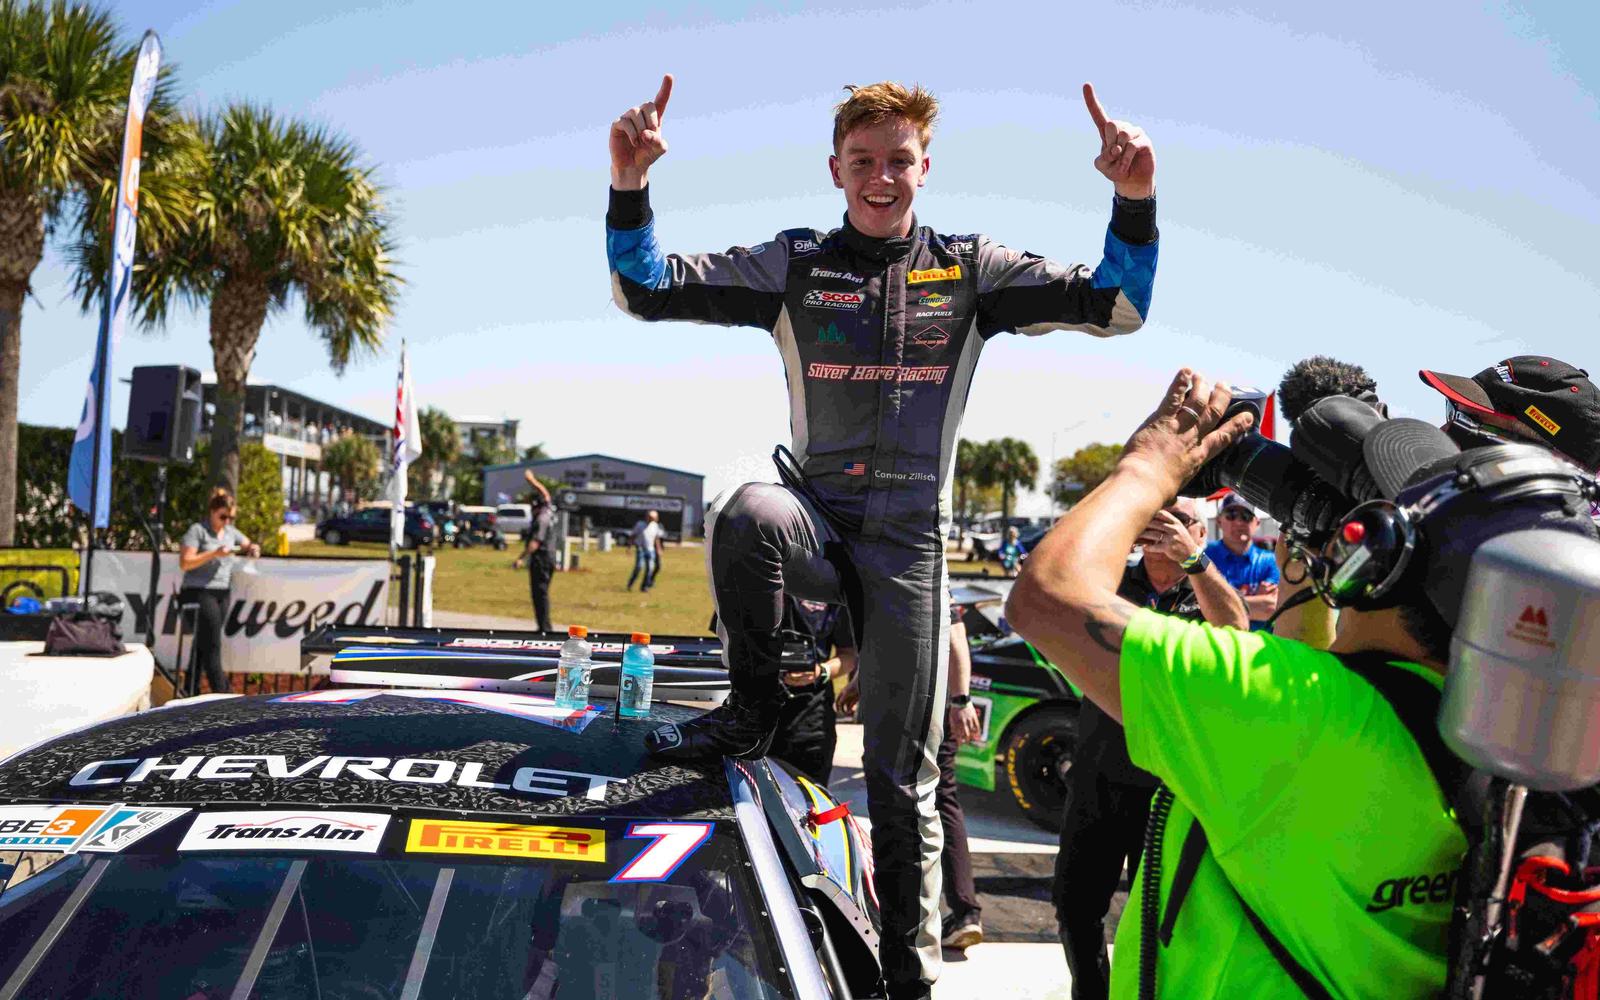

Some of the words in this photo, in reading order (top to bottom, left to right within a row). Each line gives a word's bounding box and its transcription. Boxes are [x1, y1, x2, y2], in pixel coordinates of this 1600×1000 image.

[809, 267, 842, 279] Trans
[842, 272, 864, 284] Am
[911, 266, 957, 281] PIRELLI
[821, 292, 861, 303] SCCA
[824, 301, 860, 309] RACING
[919, 296, 952, 304] SUNOCO
[807, 363, 851, 380] Silver
[850, 365, 897, 381] Hare
[896, 365, 950, 385] Racing
[1528, 408, 1557, 432] PIRELLI
[874, 469, 907, 480] Connor
[224, 580, 386, 638] weed
[68, 754, 628, 802] CHEVROLET
[0, 819, 76, 835] BE3
[113, 813, 174, 846] SERIES
[206, 824, 301, 840] Trans
[299, 824, 365, 841] Am
[0, 837, 62, 845] CTURE
[419, 824, 594, 856] PIRELLI
[609, 821, 716, 884] 7
